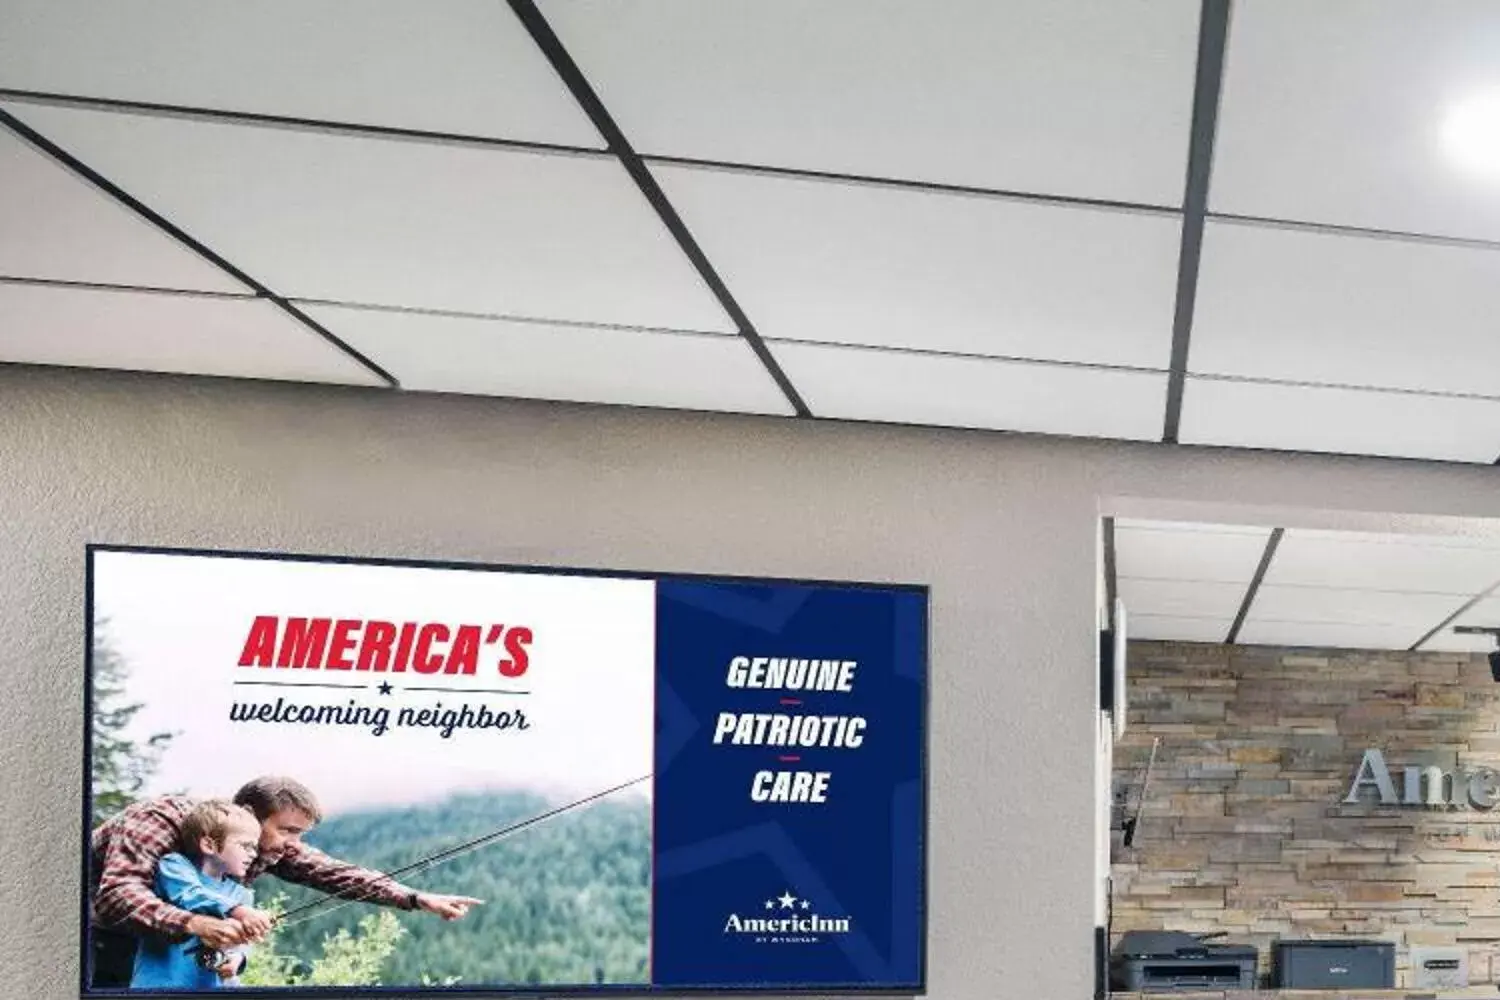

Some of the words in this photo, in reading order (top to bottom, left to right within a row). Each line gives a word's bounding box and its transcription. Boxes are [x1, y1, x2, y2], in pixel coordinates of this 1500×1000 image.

[237, 615, 534, 678] AMERICA'S
[726, 655, 857, 691] GENUINE
[229, 697, 391, 737] welcoming
[397, 701, 531, 739] neighbor
[712, 711, 867, 748] PATRIOTIC
[750, 770, 832, 803] CARE
[724, 913, 849, 932] AmericInn
